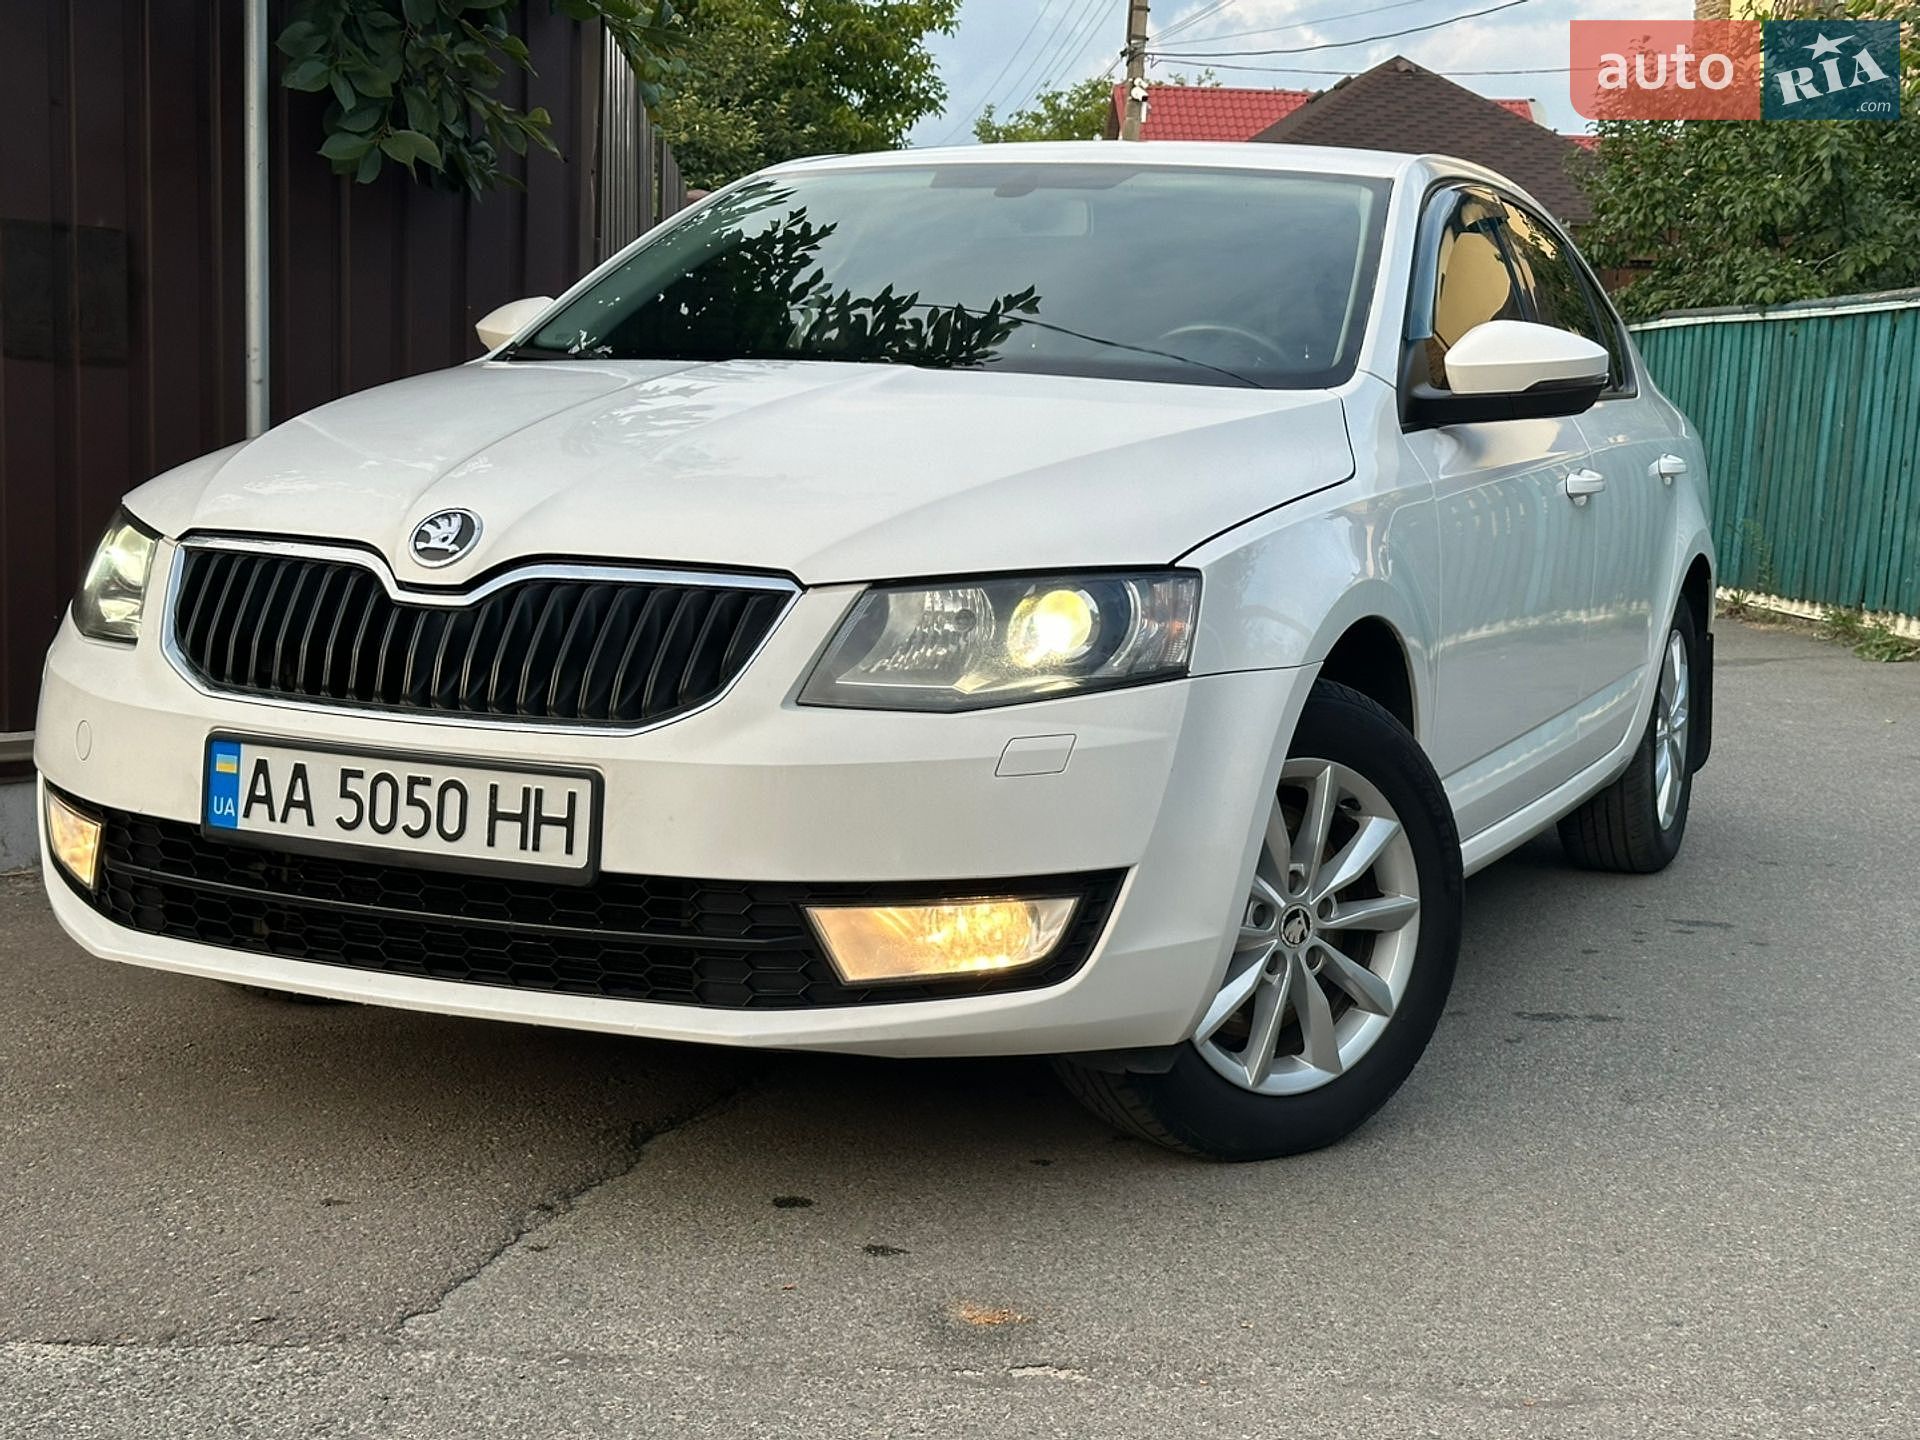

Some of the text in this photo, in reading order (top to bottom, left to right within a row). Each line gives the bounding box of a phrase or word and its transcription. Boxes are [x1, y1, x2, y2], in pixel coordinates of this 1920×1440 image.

[213, 796, 236, 817] UA
[243, 758, 577, 855] AA 5050 HH
